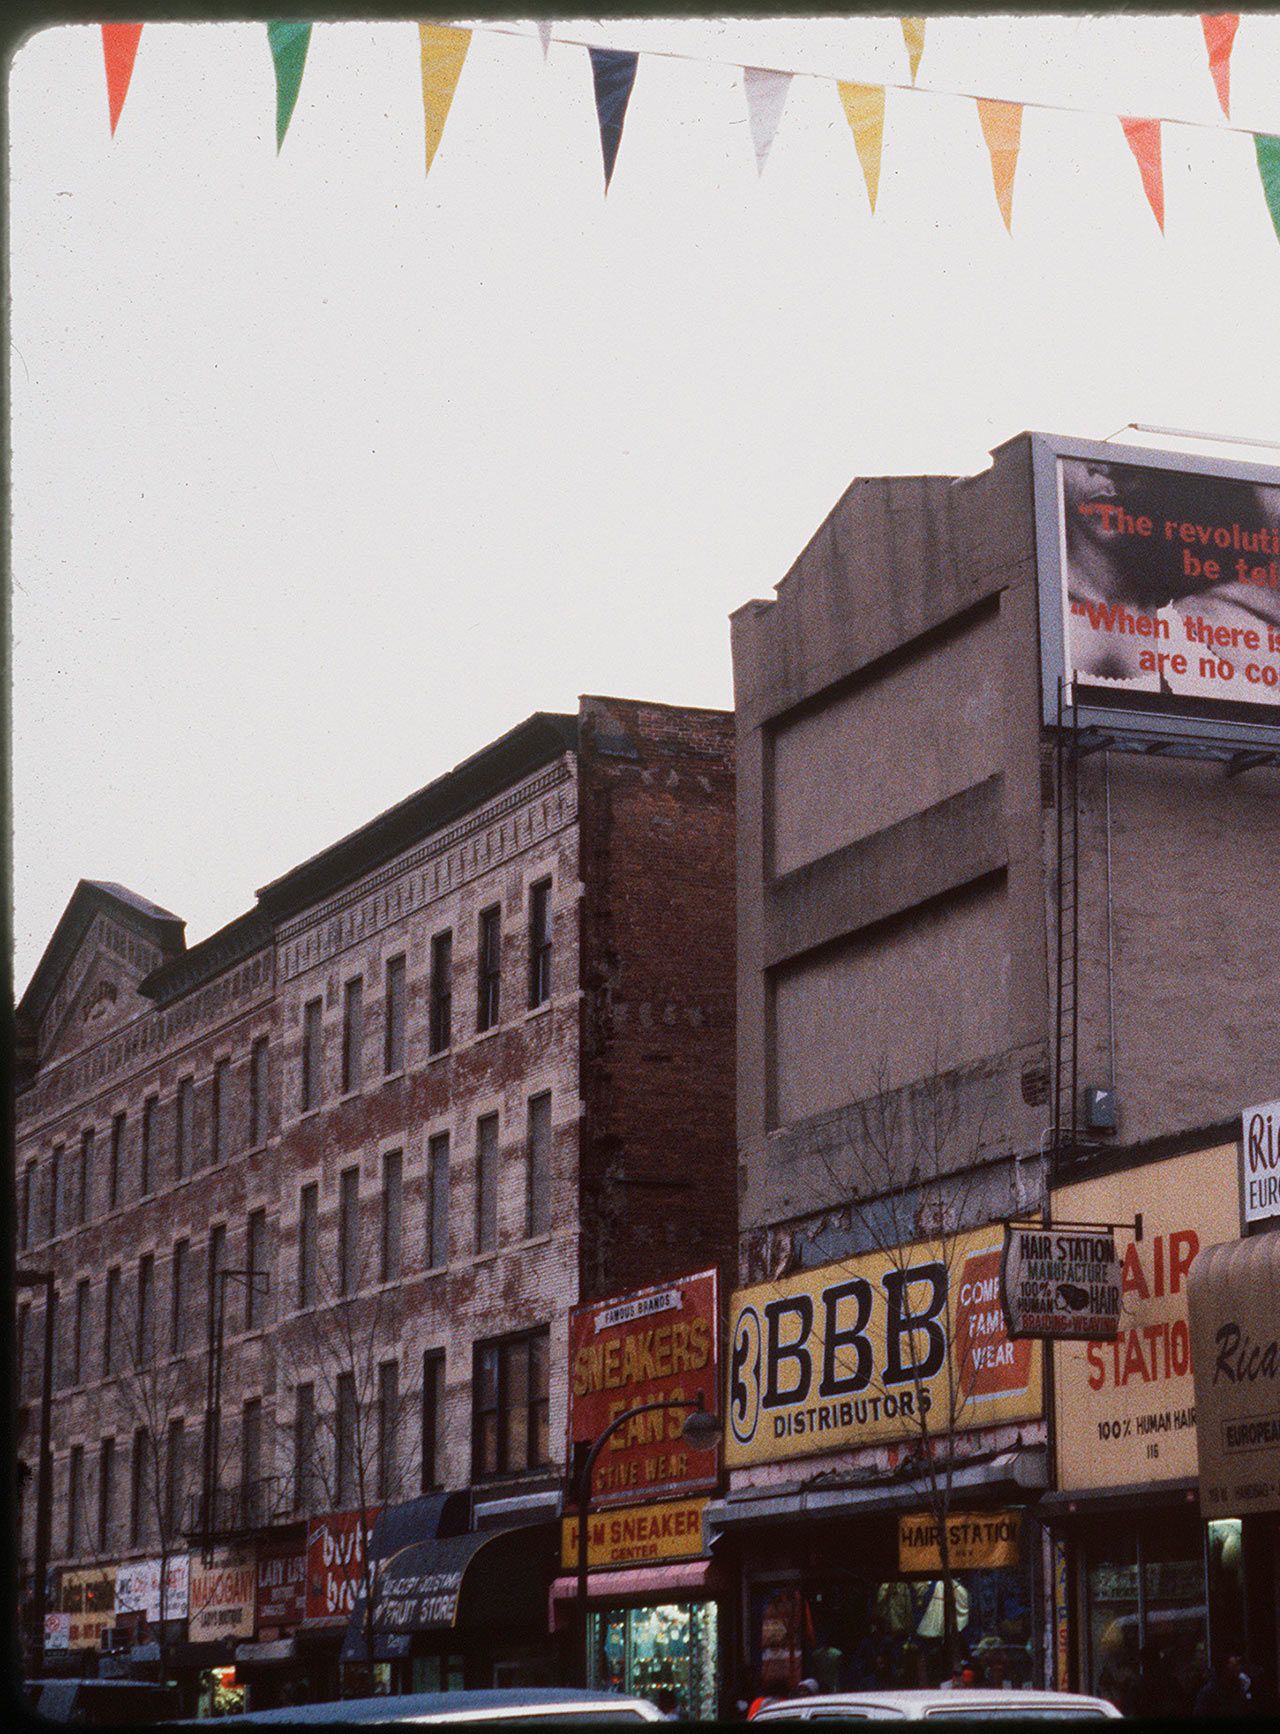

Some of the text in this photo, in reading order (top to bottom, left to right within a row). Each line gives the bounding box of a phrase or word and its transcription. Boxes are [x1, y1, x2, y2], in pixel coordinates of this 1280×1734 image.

[1182, 548, 1221, 579] be
[1183, 615, 1261, 650] there
[1138, 649, 1188, 675] are
[1199, 657, 1236, 681] no
[1020, 1234, 1115, 1263] HAIR STATION
[1121, 1229, 1200, 1299] AIR
[1027, 1260, 1108, 1284] MANUFACTURE
[604, 1293, 671, 1324] FAMOUS BRANDS
[761, 1259, 949, 1410] BBB
[573, 1316, 709, 1397] SNEAKERS
[971, 1340, 1015, 1371] WEAR
[1086, 1319, 1193, 1391] STATIO
[773, 1388, 933, 1439] DISTRIBUTORS
[1098, 1407, 1199, 1441] 100% HUMAN HAIR
[597, 1452, 688, 1490] CTIVE WEAR
[610, 1509, 700, 1544] SNEAKER
[902, 1519, 1017, 1548] HAIR STATION
[610, 1543, 659, 1561] CENTER
[420, 1594, 457, 1623] STORE
